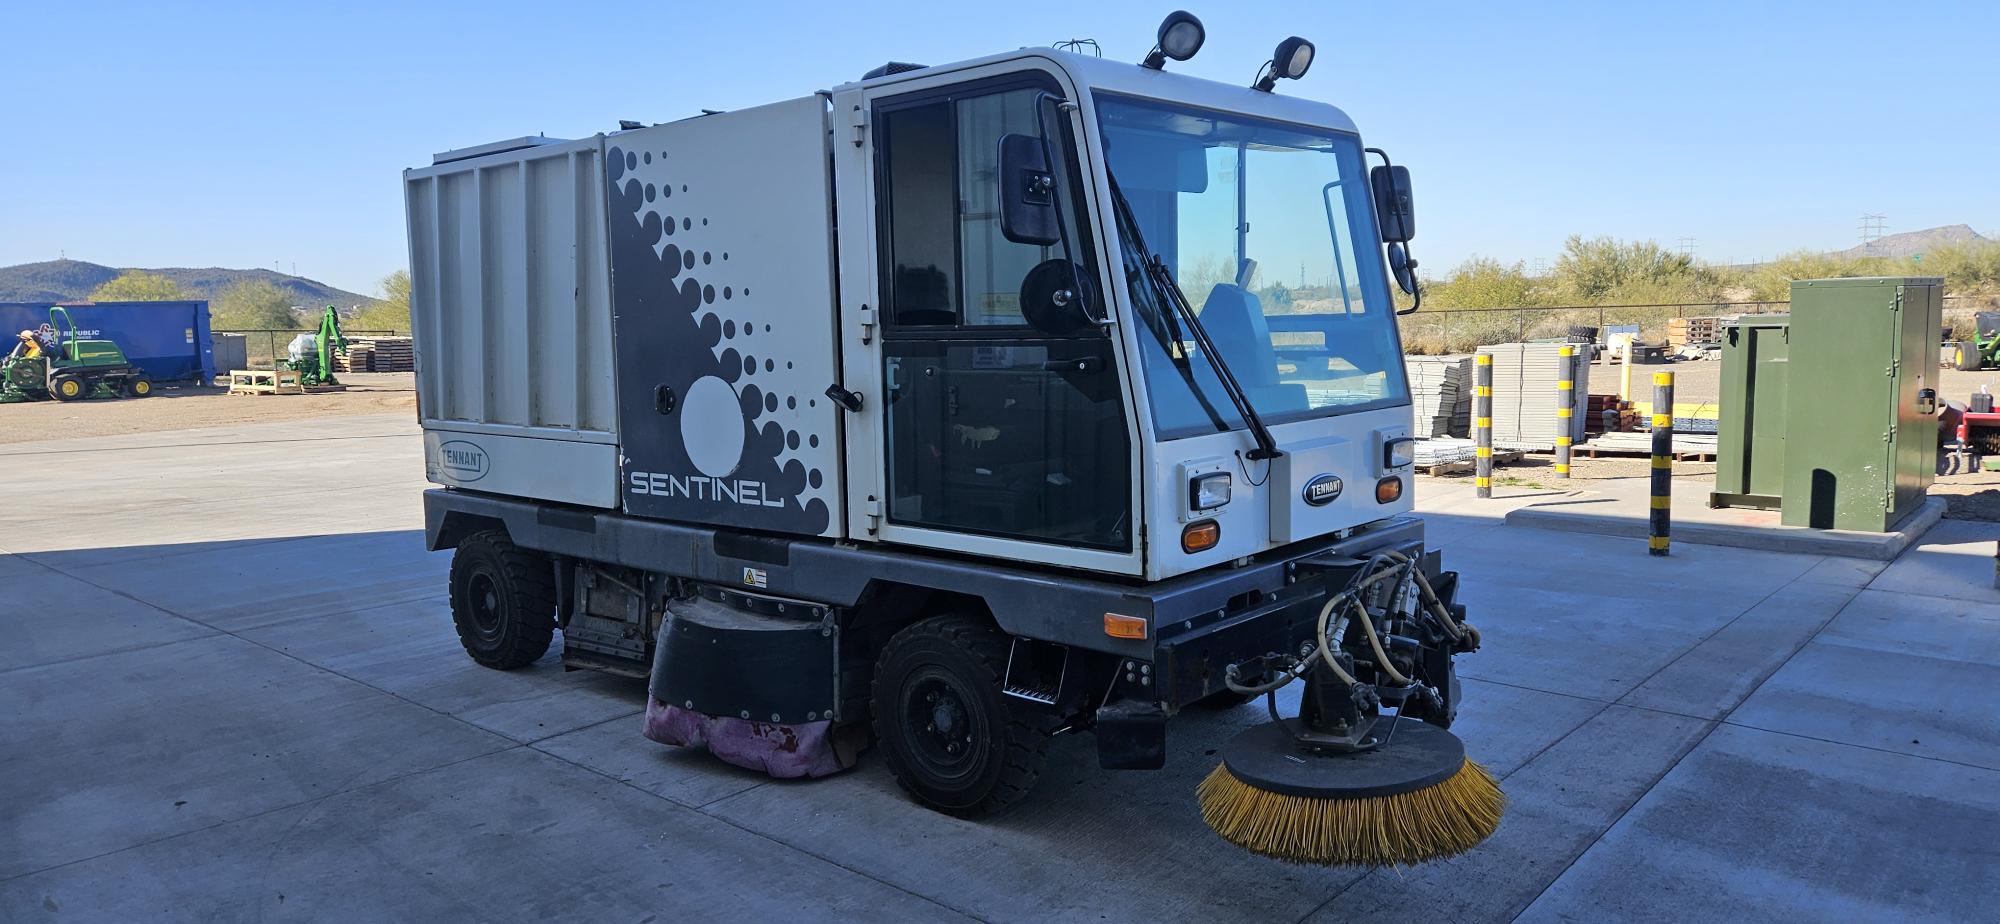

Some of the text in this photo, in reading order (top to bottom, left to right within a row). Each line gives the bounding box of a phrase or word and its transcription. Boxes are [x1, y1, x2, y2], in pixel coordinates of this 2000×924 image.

[63, 329, 100, 337] REUBLIC
[442, 449, 482, 472] TENNANT
[630, 471, 785, 508] SENTINEL
[1311, 479, 1341, 500] TENNANT
